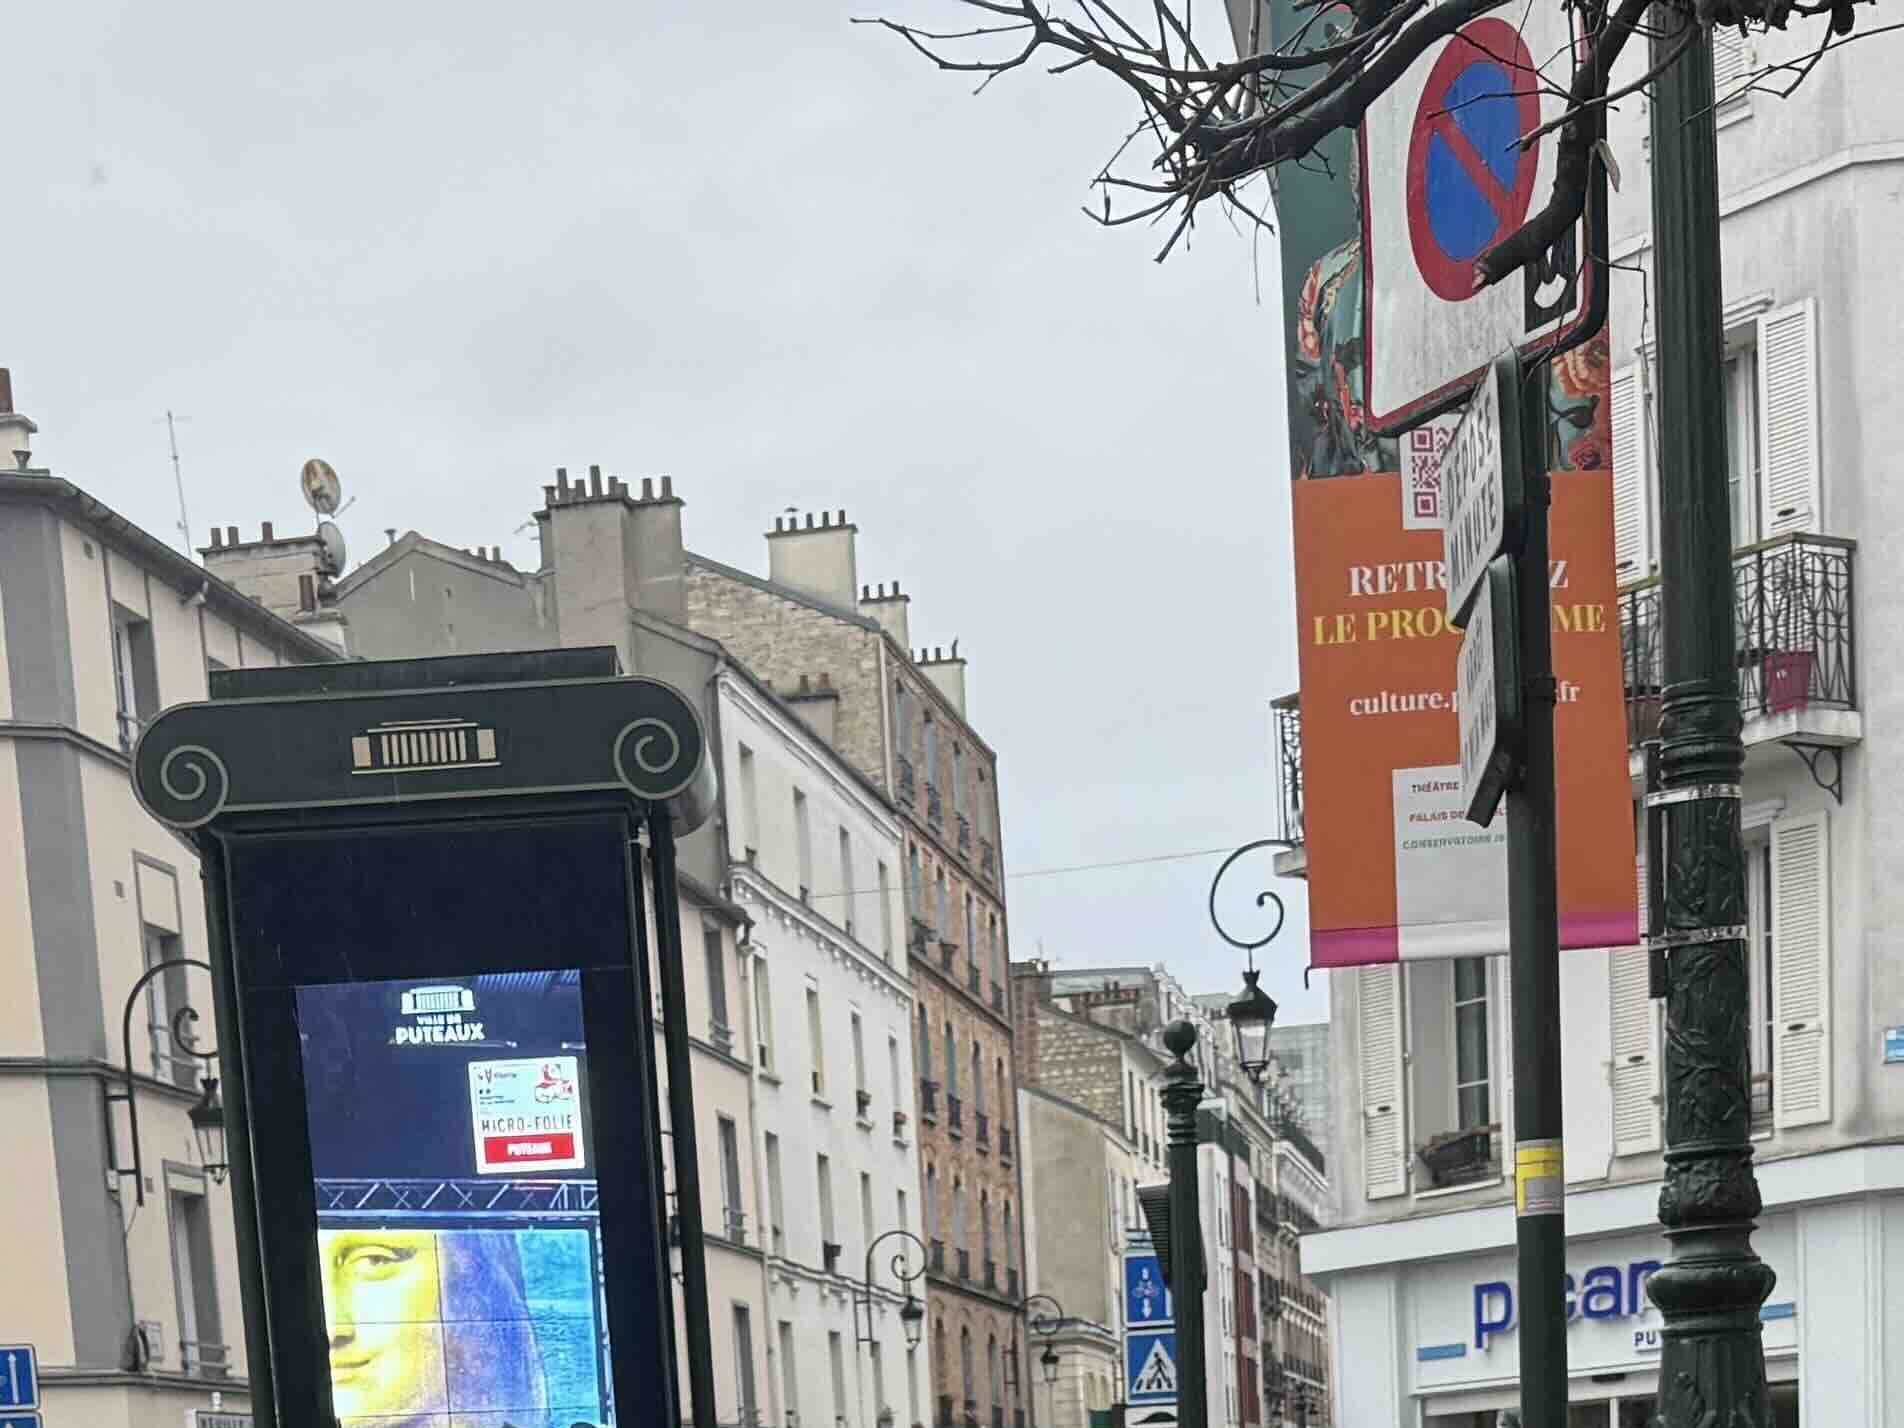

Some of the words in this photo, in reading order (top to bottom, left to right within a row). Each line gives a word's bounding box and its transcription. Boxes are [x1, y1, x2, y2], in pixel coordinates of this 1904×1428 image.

[1348, 560, 1569, 596] RETRZ
[1312, 613, 1358, 646] LE
[395, 1022, 486, 1045] PUTEAUX
[481, 1114, 574, 1133] MICRO-FOLIE
